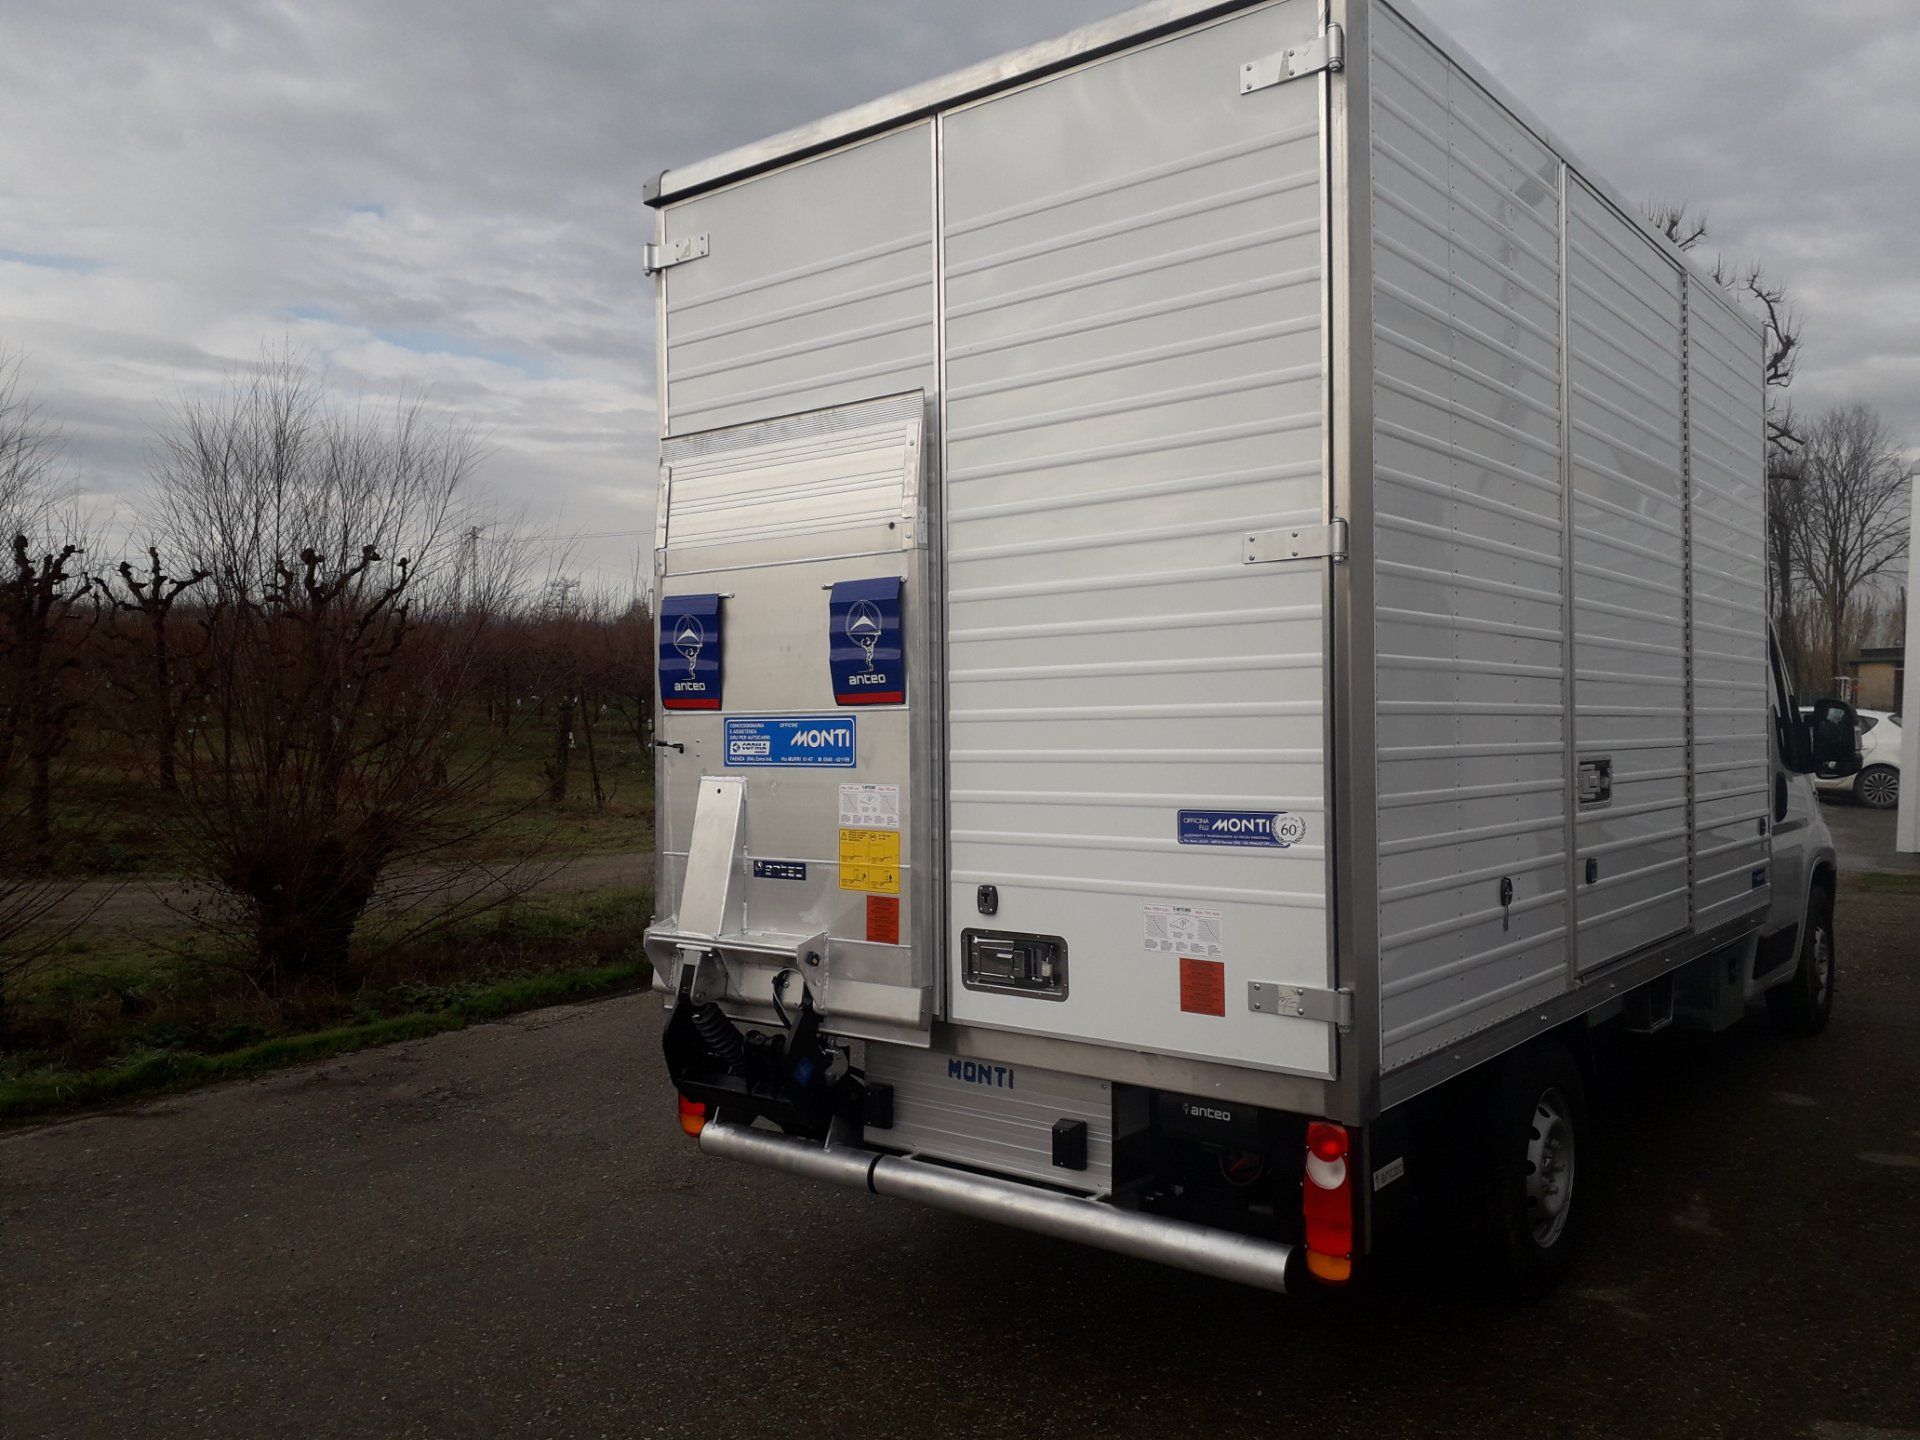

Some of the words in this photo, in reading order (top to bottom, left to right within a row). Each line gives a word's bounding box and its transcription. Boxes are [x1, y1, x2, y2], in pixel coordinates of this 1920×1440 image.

[674, 682, 706, 691] anteo
[848, 674, 886, 685] anteo
[790, 728, 850, 747] MONTI
[1212, 818, 1270, 833] MONTI
[948, 1058, 1014, 1090] MONTI
[1191, 1106, 1231, 1121] anteo
